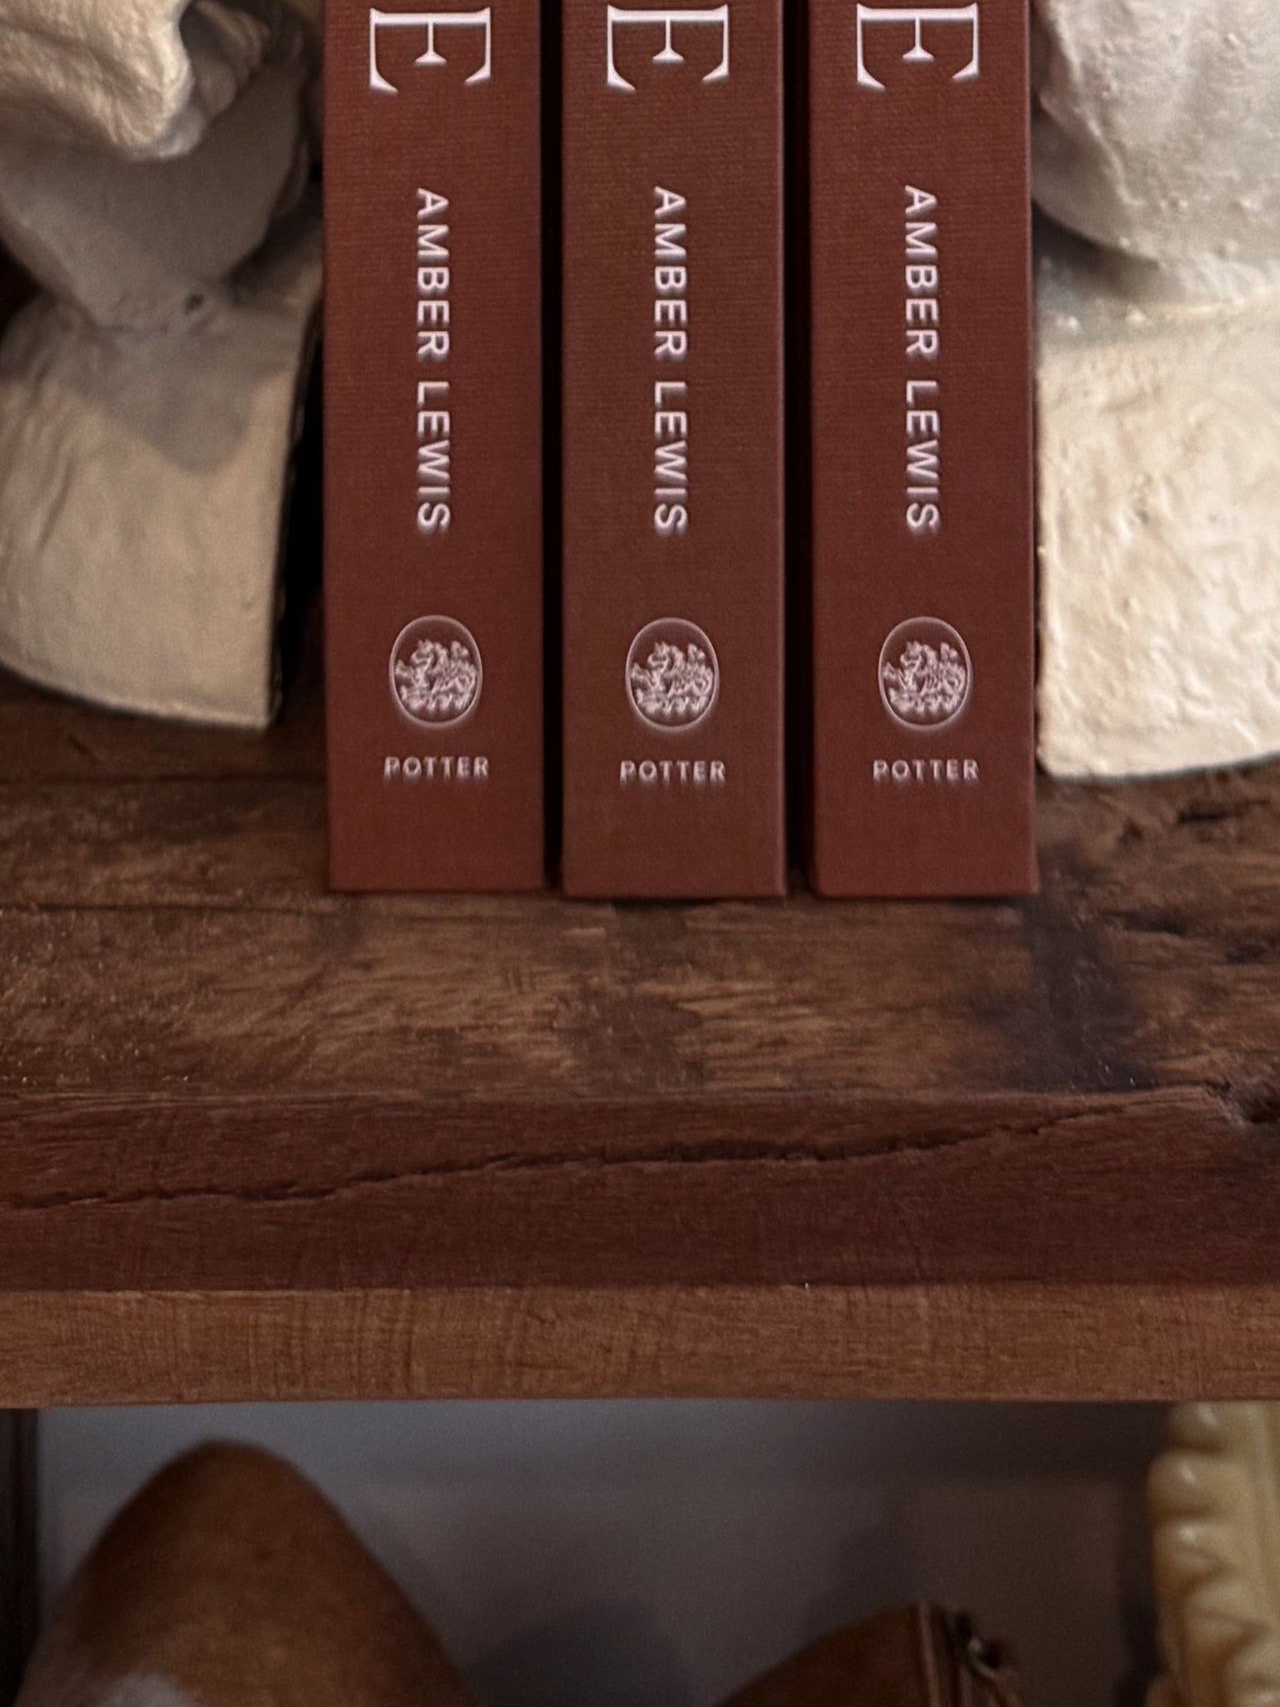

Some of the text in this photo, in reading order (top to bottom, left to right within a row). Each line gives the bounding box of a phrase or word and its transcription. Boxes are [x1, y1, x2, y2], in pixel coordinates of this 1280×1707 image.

[415, 186, 452, 532] AMBER LEWIS
[652, 185, 689, 535] AMBER LEWIS
[903, 184, 941, 534] AMBER LEWIS
[383, 755, 489, 782] POTTER
[619, 759, 726, 786] POTTER
[872, 758, 979, 785] POTTER
